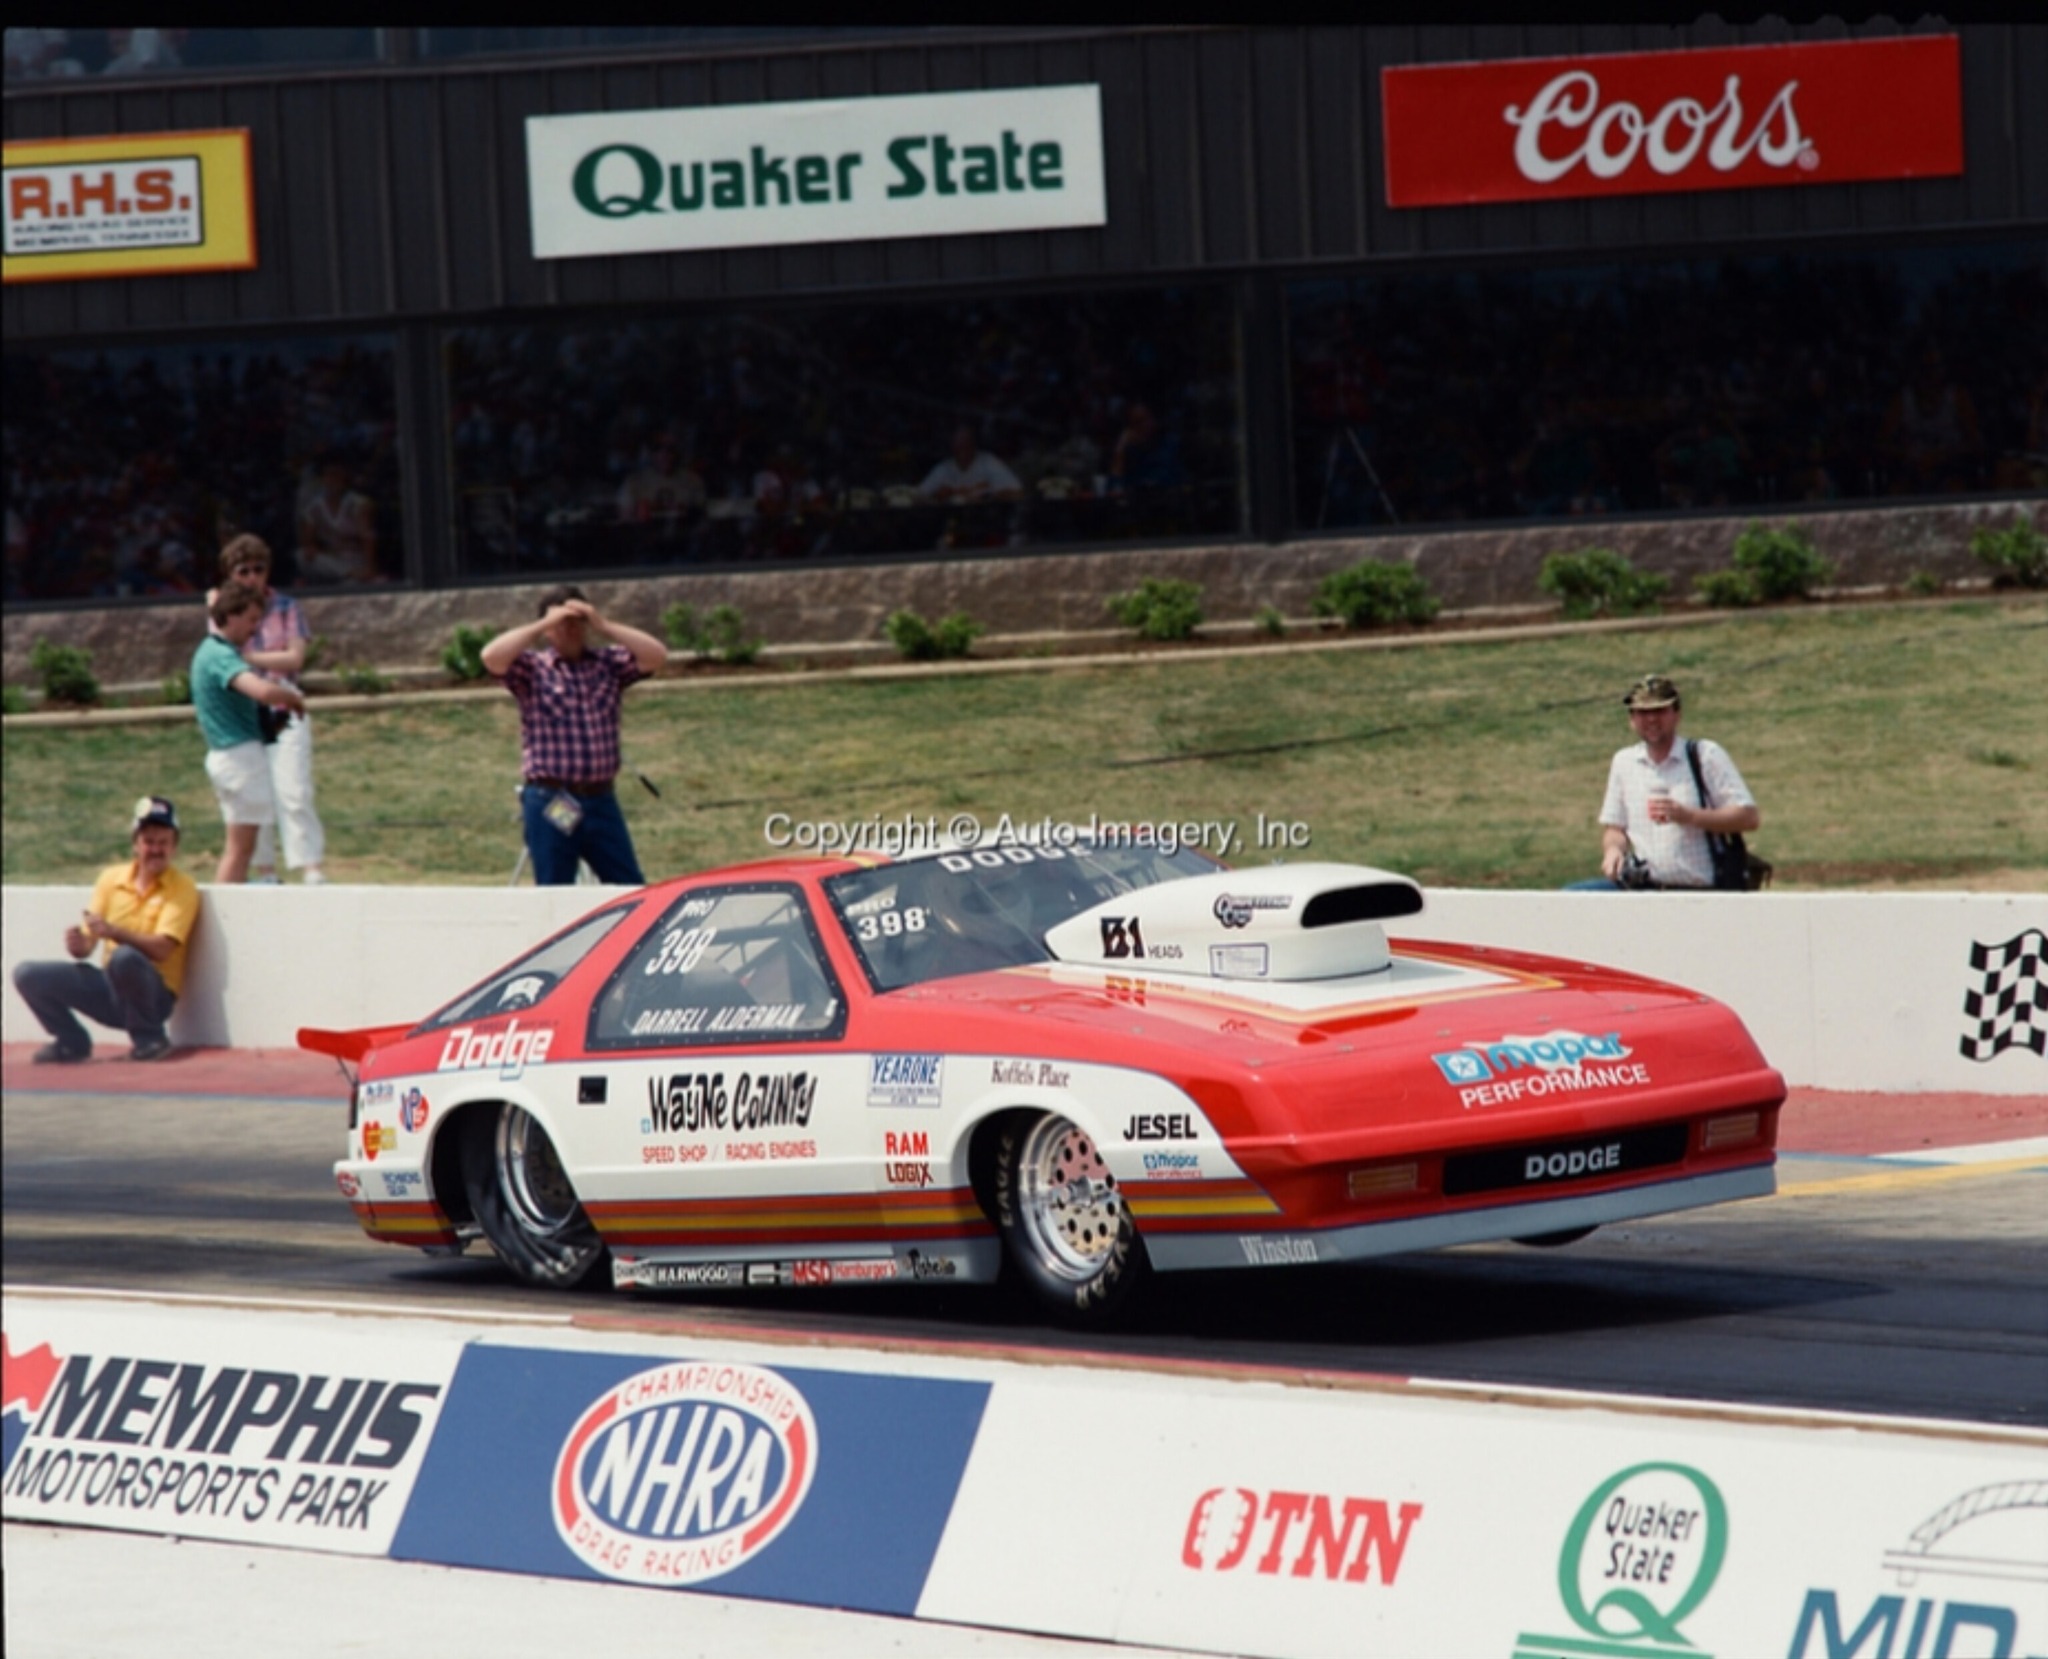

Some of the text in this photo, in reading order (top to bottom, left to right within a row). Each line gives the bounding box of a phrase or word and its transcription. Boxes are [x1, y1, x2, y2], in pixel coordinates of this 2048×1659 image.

[1504, 70, 1812, 182] Coors
[10, 169, 191, 221] R.H.S.
[572, 130, 1064, 219] Quaker State
[857, 906, 927, 941] 398
[645, 926, 718, 975] 398
[631, 1003, 806, 1035] DARRELL ALDERMAN
[437, 1018, 555, 1081] Dodge
[1038, 1063, 1071, 1089] Place
[1459, 1063, 1652, 1110] PERFORMANCE
[886, 1131, 929, 1156] RAM
[1122, 1113, 1198, 1141] JESEL
[643, 1145, 675, 1164] SPEED
[679, 1144, 708, 1163] SHOP
[725, 1142, 767, 1161] RACING
[769, 1139, 818, 1159] ENGINES
[1525, 1144, 1621, 1181] DODGE
[886, 1162, 934, 1188] LOGIX
[793, 1258, 832, 1286] MSD
[1239, 1235, 1318, 1264] Winston
[657, 1264, 729, 1284] HARWOOD
[32, 1355, 441, 1469] MEMPHIS
[623, 1367, 794, 1424] CHAMPIONSHIP
[5, 1447, 389, 1530] MOTORSPORTS PARK
[587, 1404, 773, 1536] NHRA
[1257, 1490, 1424, 1586] TNN
[1605, 1496, 1700, 1542] Quaker
[574, 1521, 734, 1577] DRAG RACING
[1604, 1540, 1676, 1584] State
